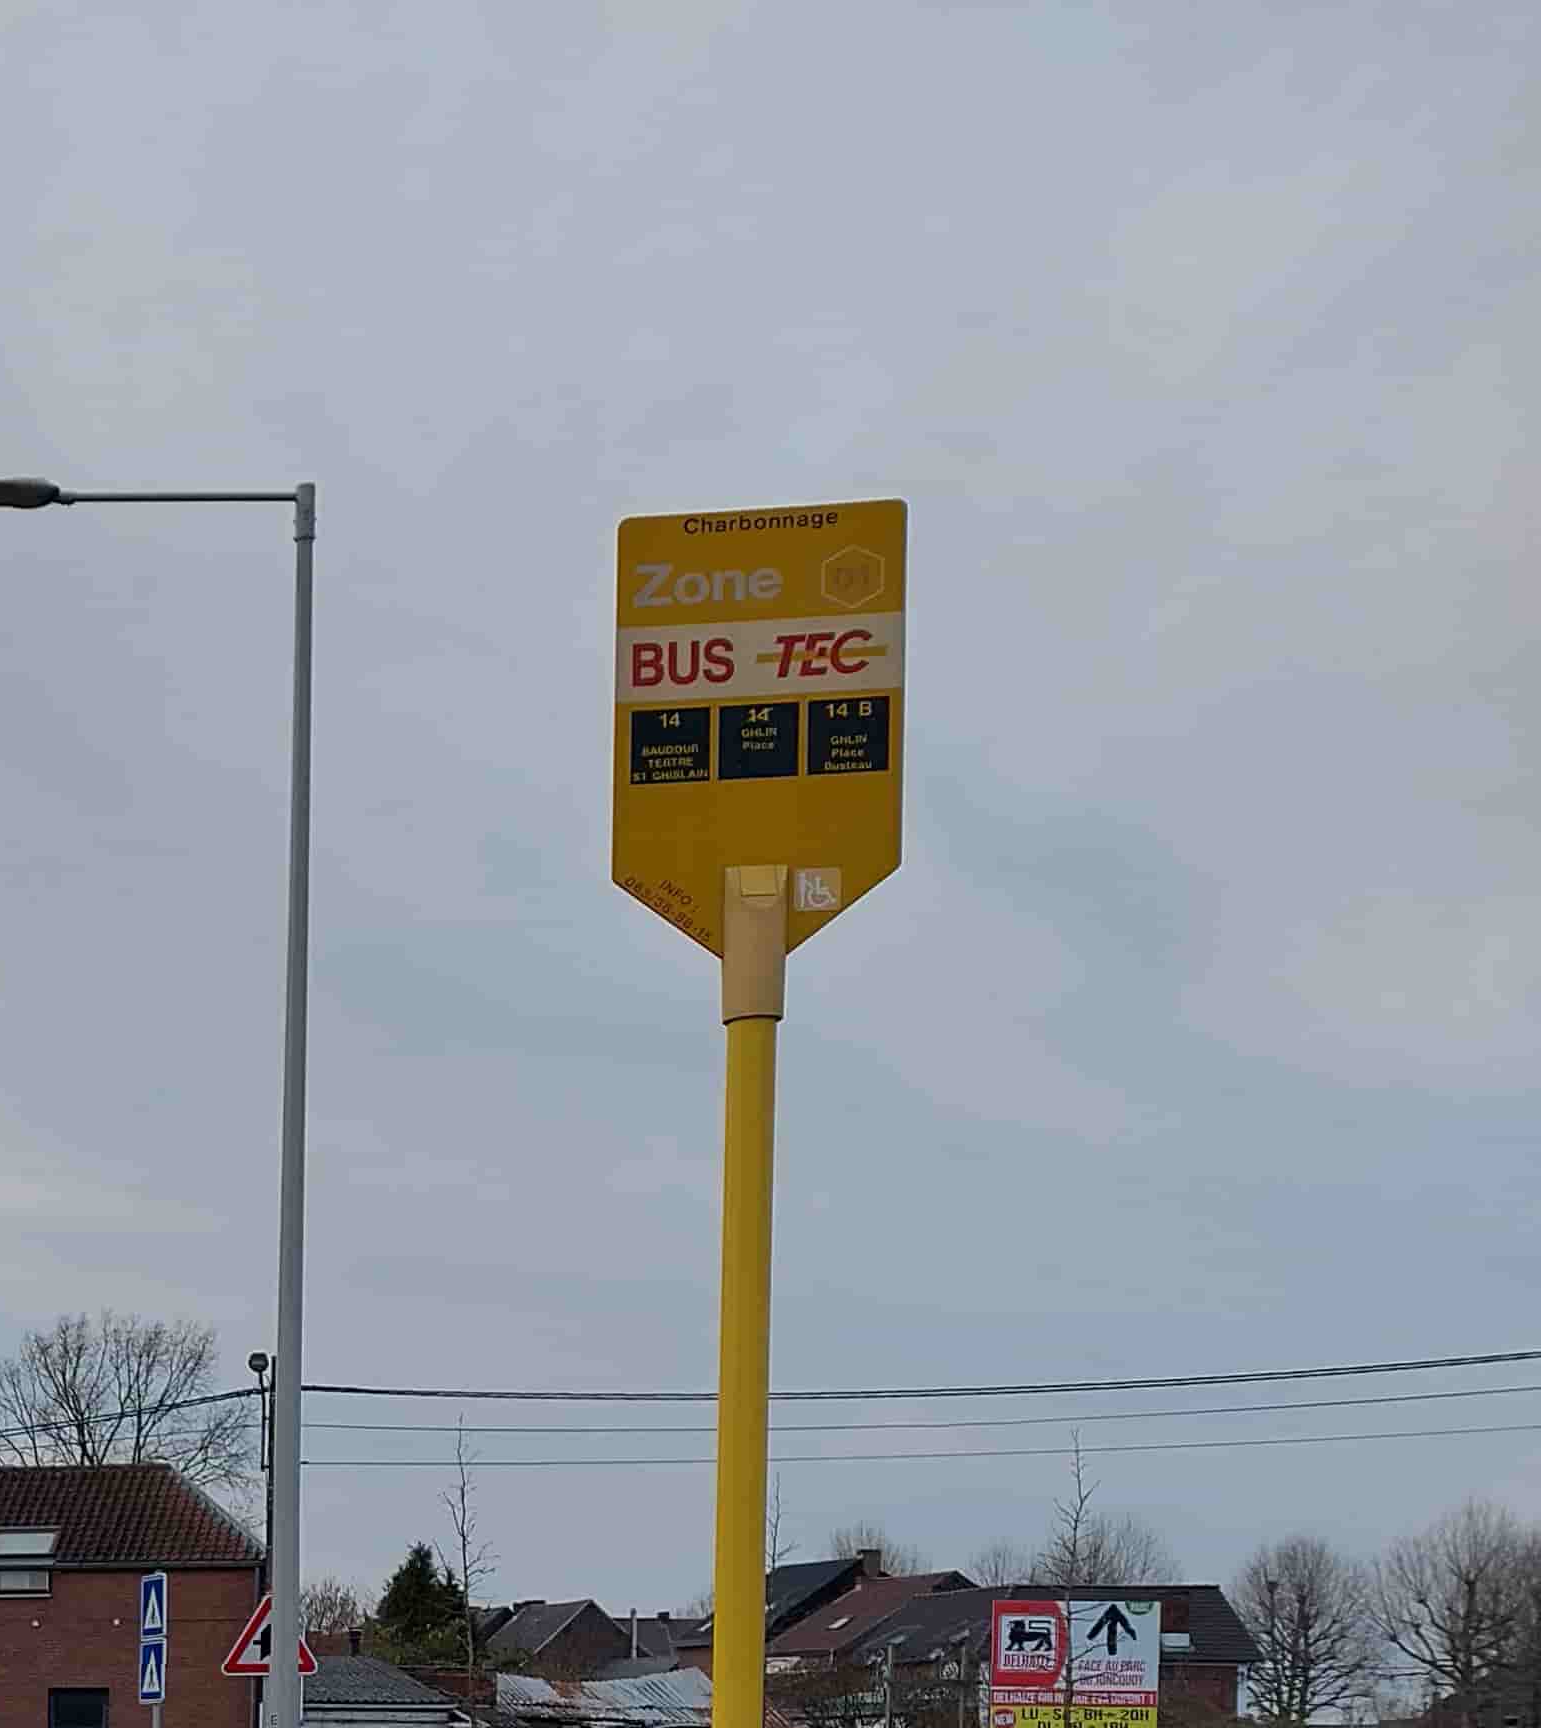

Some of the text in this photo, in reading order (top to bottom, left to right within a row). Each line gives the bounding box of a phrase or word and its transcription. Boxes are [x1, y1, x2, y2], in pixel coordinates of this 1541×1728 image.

[684, 511, 838, 534] Charbonnage
[633, 563, 783, 608] Zone
[631, 629, 872, 687] BUS TEC
[747, 708, 774, 723] 14
[826, 701, 872, 718] 14 B
[660, 712, 681, 729] 14
